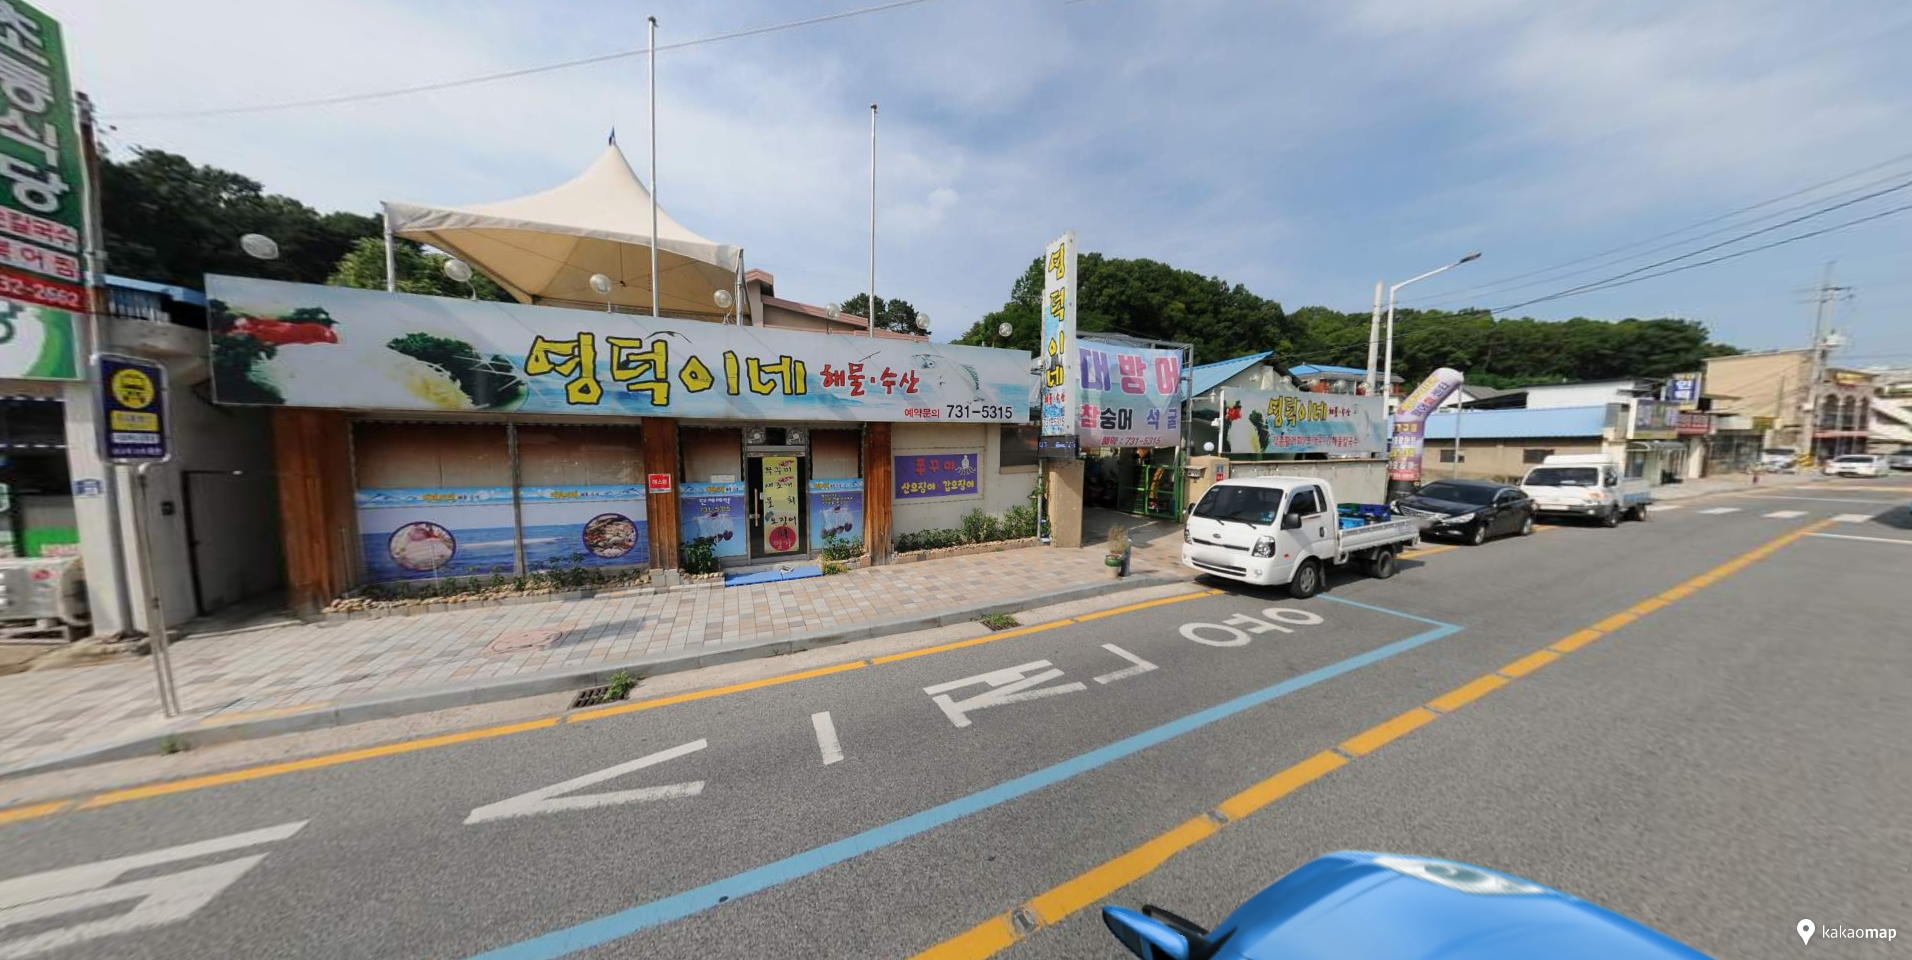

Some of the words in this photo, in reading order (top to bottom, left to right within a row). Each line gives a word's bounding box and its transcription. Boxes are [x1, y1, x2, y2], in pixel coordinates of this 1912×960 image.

[1047, 242, 1065, 388] 영덕이네
[524, 331, 807, 406] 영덕이네
[1079, 347, 1180, 395] 대방어
[904, 407, 940, 418] 예약문의
[946, 404, 1013, 419] 731-5315
[1080, 403, 1133, 430] 참숭어
[1267, 395, 1328, 428] 영덕이네
[1125, 435, 1163, 446] 731-5315
[901, 481, 936, 495] 산오징어
[770, 516, 797, 527] 오징어
